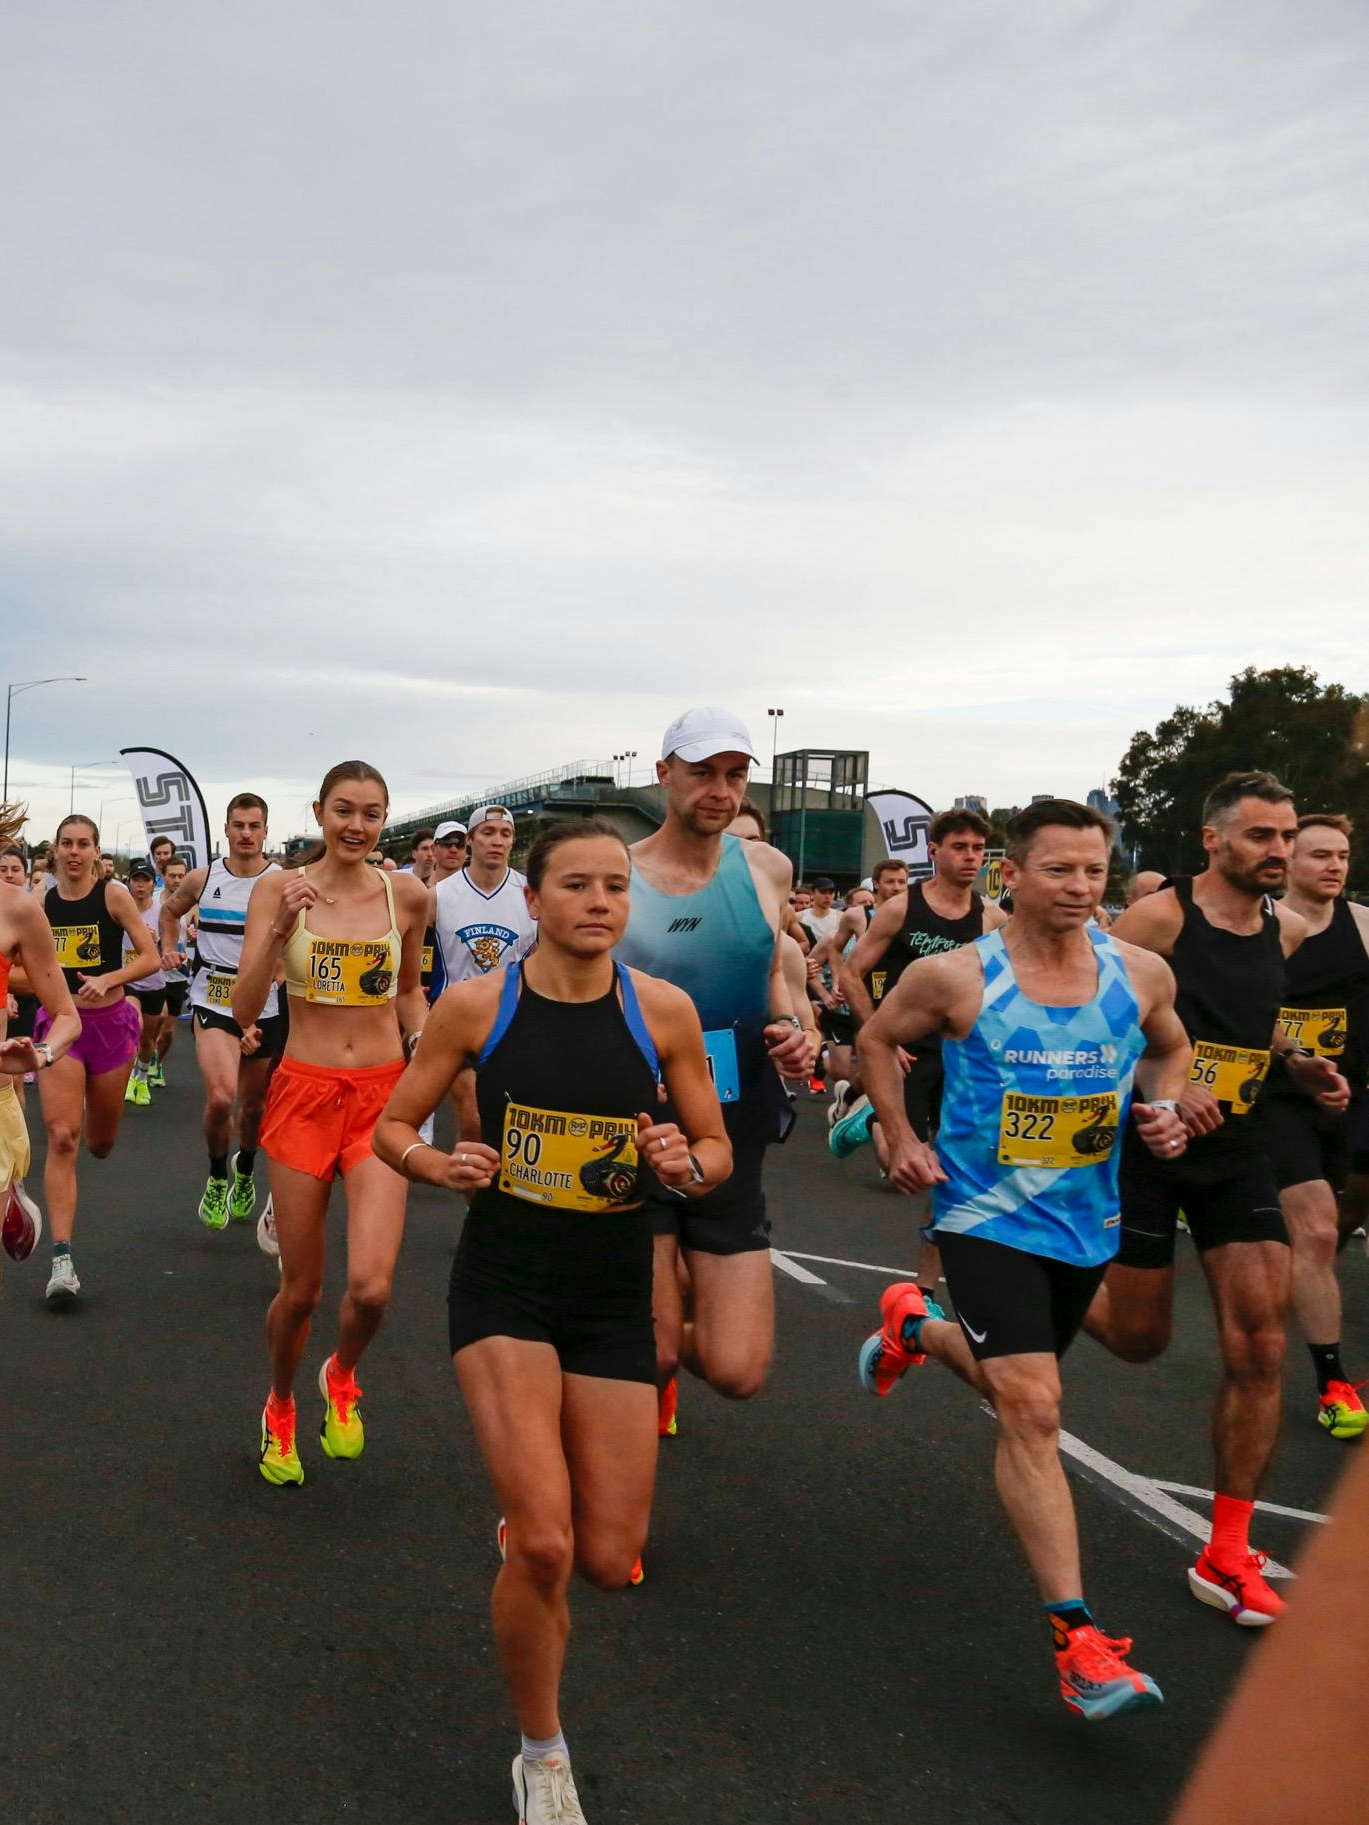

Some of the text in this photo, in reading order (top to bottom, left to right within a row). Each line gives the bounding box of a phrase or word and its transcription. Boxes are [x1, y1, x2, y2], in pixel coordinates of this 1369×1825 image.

[464, 926, 510, 939] FINLAND
[311, 942, 349, 956] 10KM
[310, 955, 341, 980] 165
[208, 984, 230, 999] 283
[313, 980, 345, 992] LORETTA
[1005, 1050, 1098, 1065] RUNNERS
[1196, 1044, 1237, 1063] 10KM
[1047, 1065, 1118, 1081] paradise
[1191, 1058, 1218, 1084] 56
[1006, 1095, 1059, 1113] 10KM
[509, 1107, 567, 1136] 10KM
[589, 1120, 636, 1143] PRIX
[1005, 1112, 1055, 1140] 322
[507, 1129, 542, 1166] 90
[509, 1163, 573, 1189] CHARLOTTE
